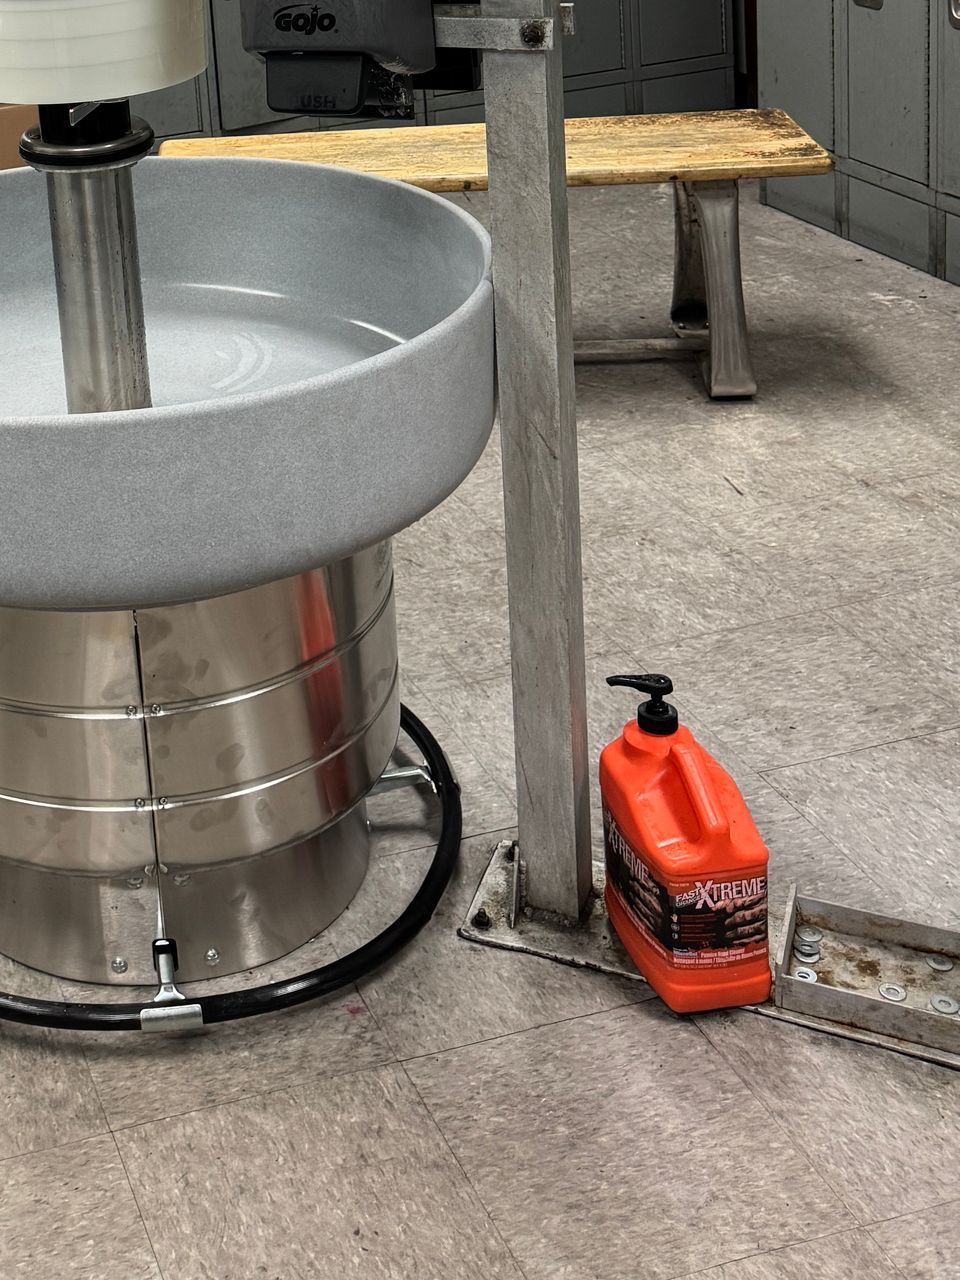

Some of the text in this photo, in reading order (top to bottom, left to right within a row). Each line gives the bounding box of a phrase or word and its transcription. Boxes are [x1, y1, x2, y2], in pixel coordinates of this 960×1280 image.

[274, 5, 337, 35] GOJO
[675, 887, 701, 903] FAST
[694, 876, 767, 910] XTREME
